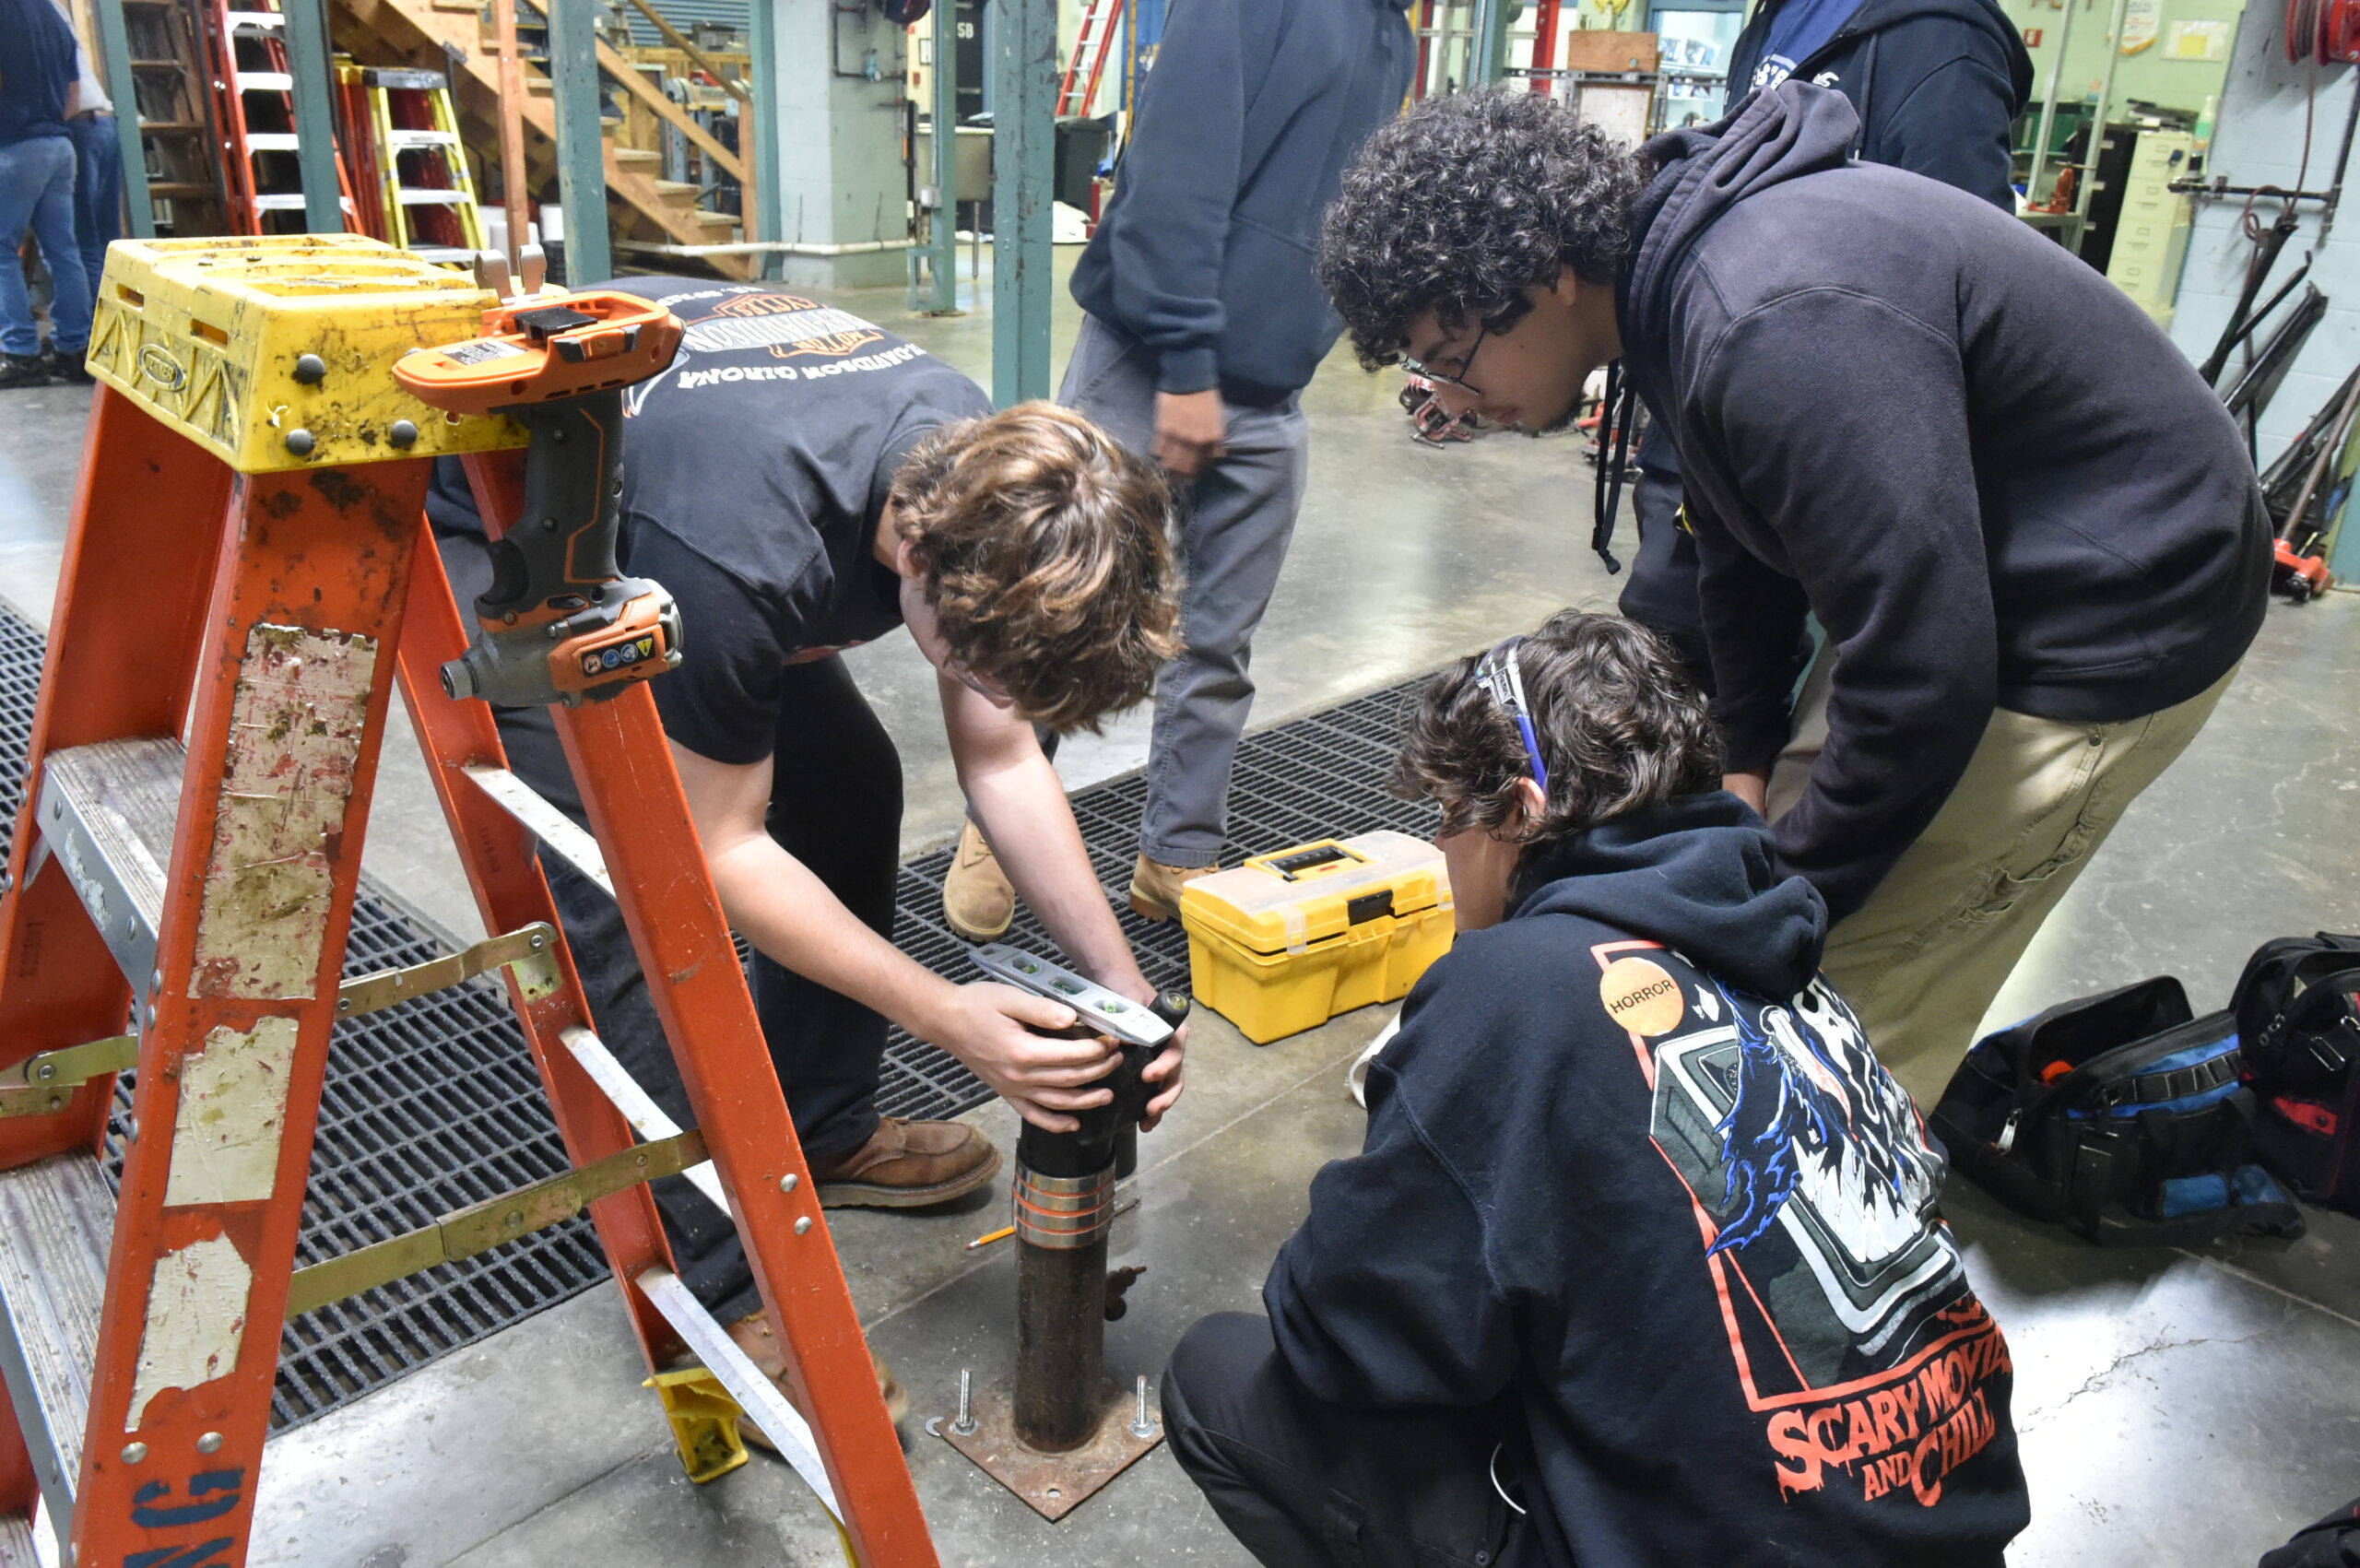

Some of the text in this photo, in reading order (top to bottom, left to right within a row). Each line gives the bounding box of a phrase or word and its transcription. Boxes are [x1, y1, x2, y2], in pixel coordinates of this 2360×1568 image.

[791, 329, 867, 352] MOTOR
[677, 365, 798, 389] GIRONA
[1610, 979, 1675, 1014] HORROR
[1766, 1323, 2013, 1505] SCARY MOVIE
[1861, 1386, 1996, 1508] AND CHILL
